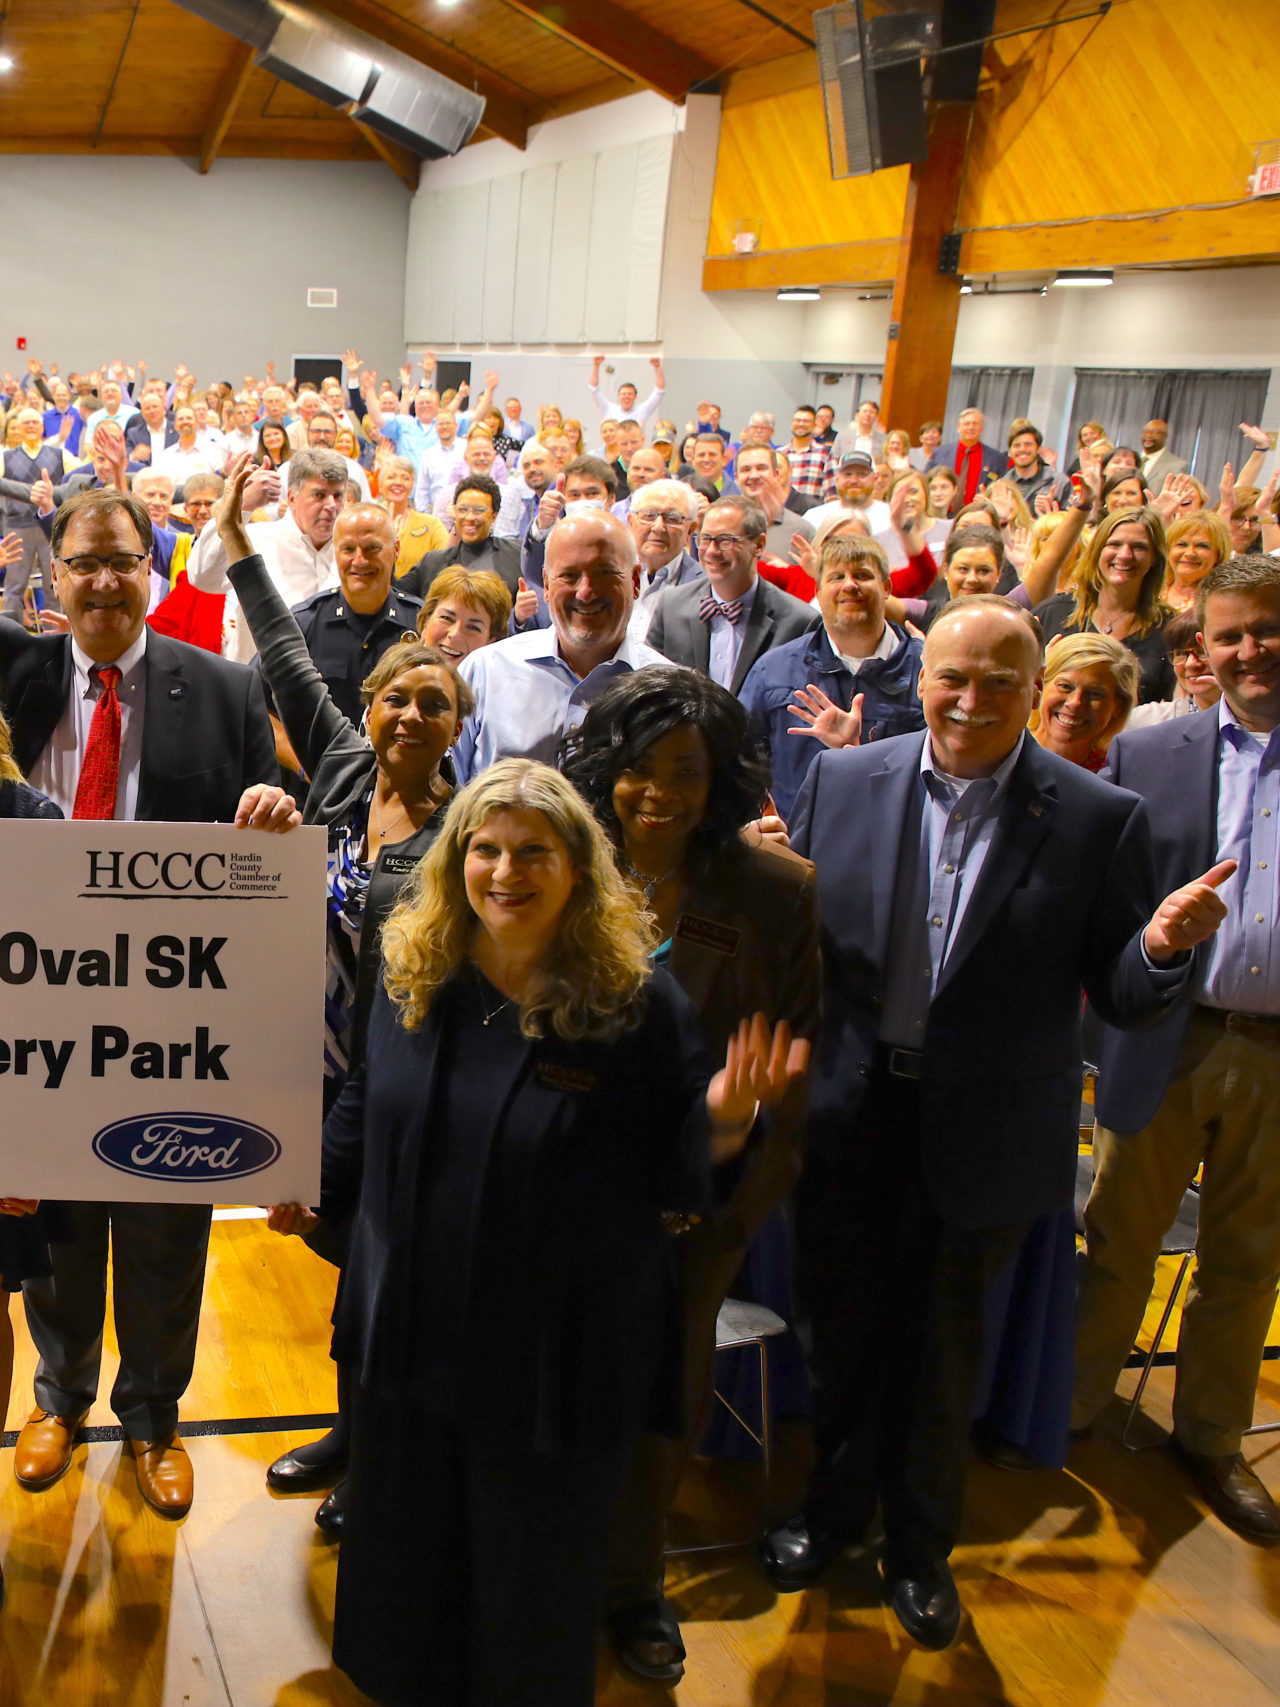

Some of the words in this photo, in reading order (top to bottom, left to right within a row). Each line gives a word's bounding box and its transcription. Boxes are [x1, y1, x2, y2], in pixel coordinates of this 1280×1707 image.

[230, 853, 262, 862] Hardin
[230, 862, 262, 873] County
[85, 851, 226, 891] HCCC
[229, 872, 270, 881] Chamber
[271, 873, 282, 882] of
[229, 882, 277, 891] Commerce
[145, 935, 229, 990] SK
[90, 1025, 231, 1081] Park
[130, 1122, 244, 1169] Ford
